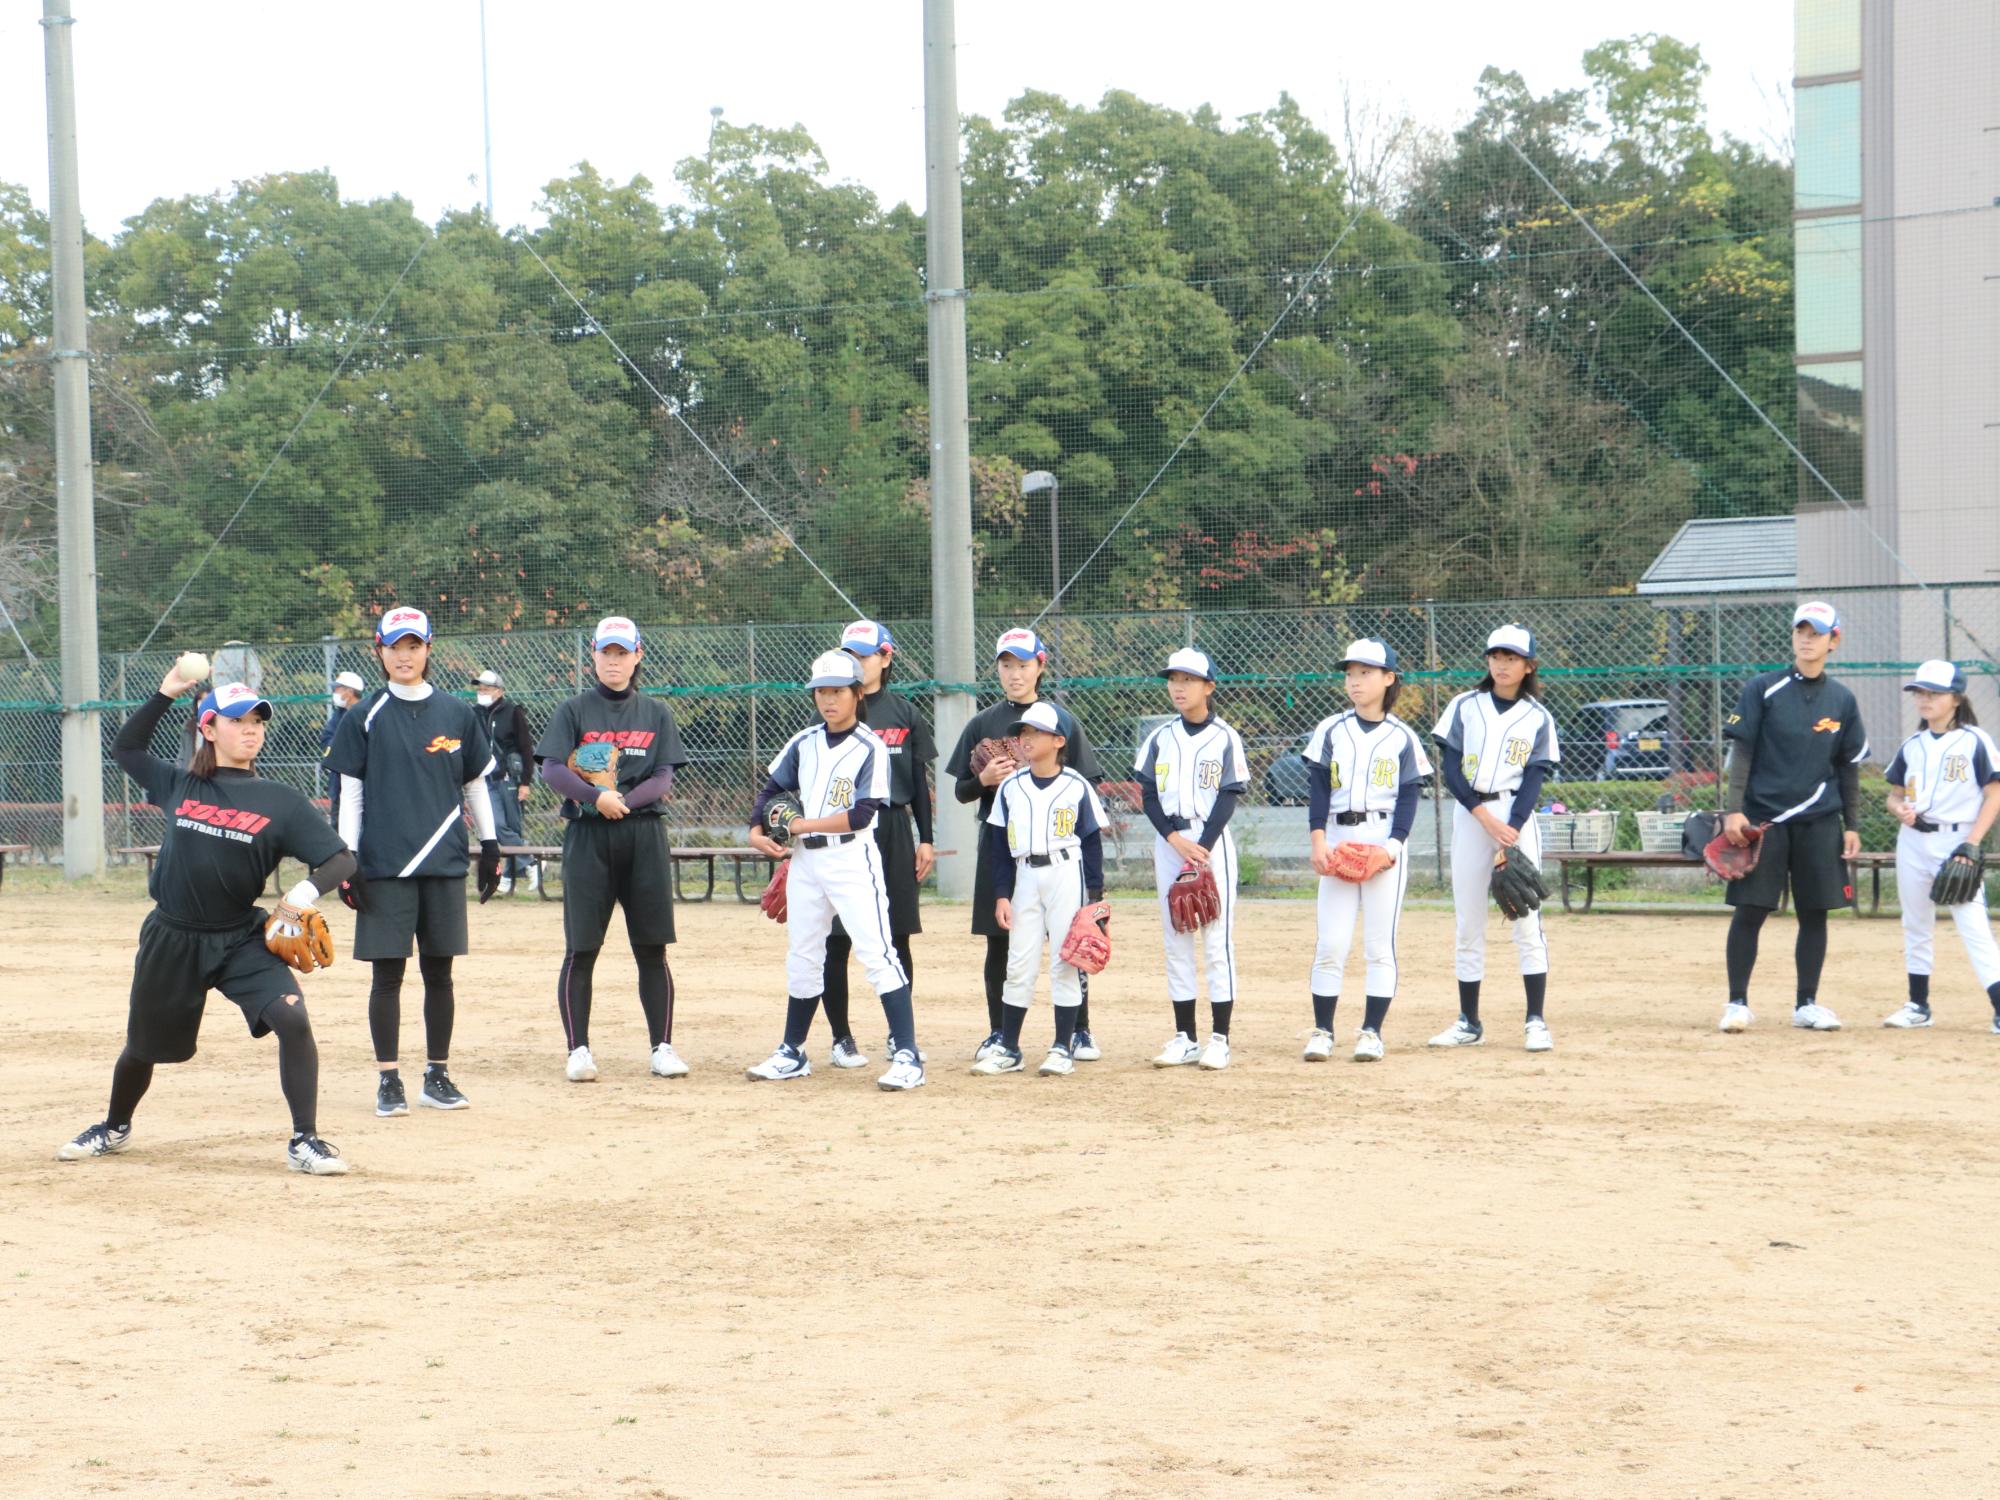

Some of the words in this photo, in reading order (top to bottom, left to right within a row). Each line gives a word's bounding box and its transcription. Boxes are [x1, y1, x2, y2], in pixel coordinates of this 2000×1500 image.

[624, 748, 646, 757] TEAM
[1155, 763, 1169, 792] 7
[828, 777, 852, 809] R
[175, 799, 271, 834] SOSHI
[176, 818, 223, 838] SOFTBALL
[225, 829, 254, 844] TEAM
